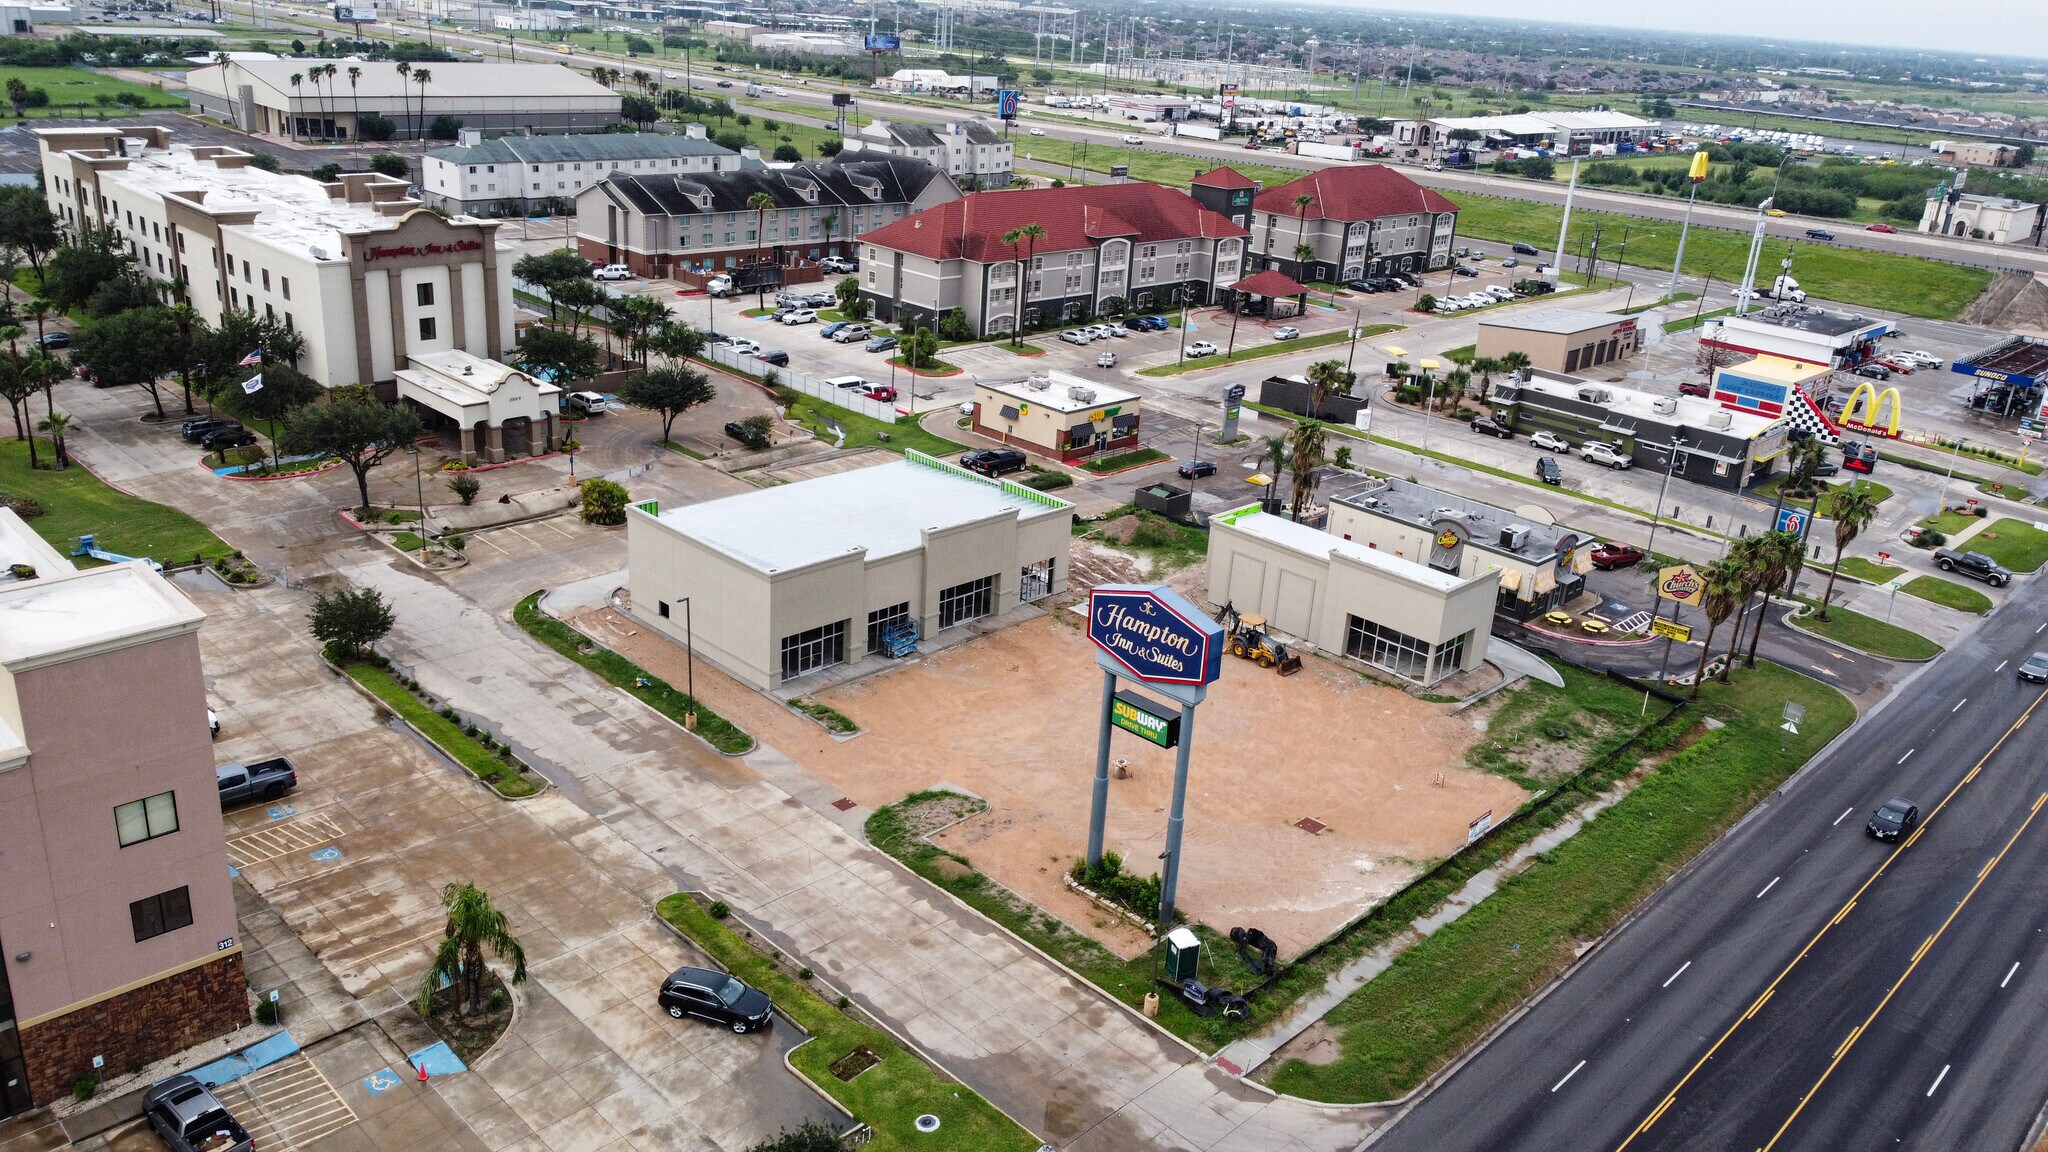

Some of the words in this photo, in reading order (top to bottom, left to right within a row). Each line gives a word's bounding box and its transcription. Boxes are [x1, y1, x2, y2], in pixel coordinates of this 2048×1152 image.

[1004, 91, 1017, 115] 6
[364, 246, 420, 262] Hampton
[420, 243, 447, 256] Inn
[453, 240, 482, 252] Suites
[1974, 369, 2009, 381] SUNOCO
[1846, 422, 1887, 437] McDonald's
[1786, 515, 1800, 532] 6
[1097, 604, 1198, 656] Hampton
[1105, 632, 1139, 655] Inn
[1138, 647, 1147, 660] &
[1146, 646, 1183, 672] Suites
[1114, 702, 1167, 732] SUBWAY
[1120, 718, 1139, 732] DRIVE
[1140, 726, 1158, 739] THRU
[218, 938, 233, 950] 312
